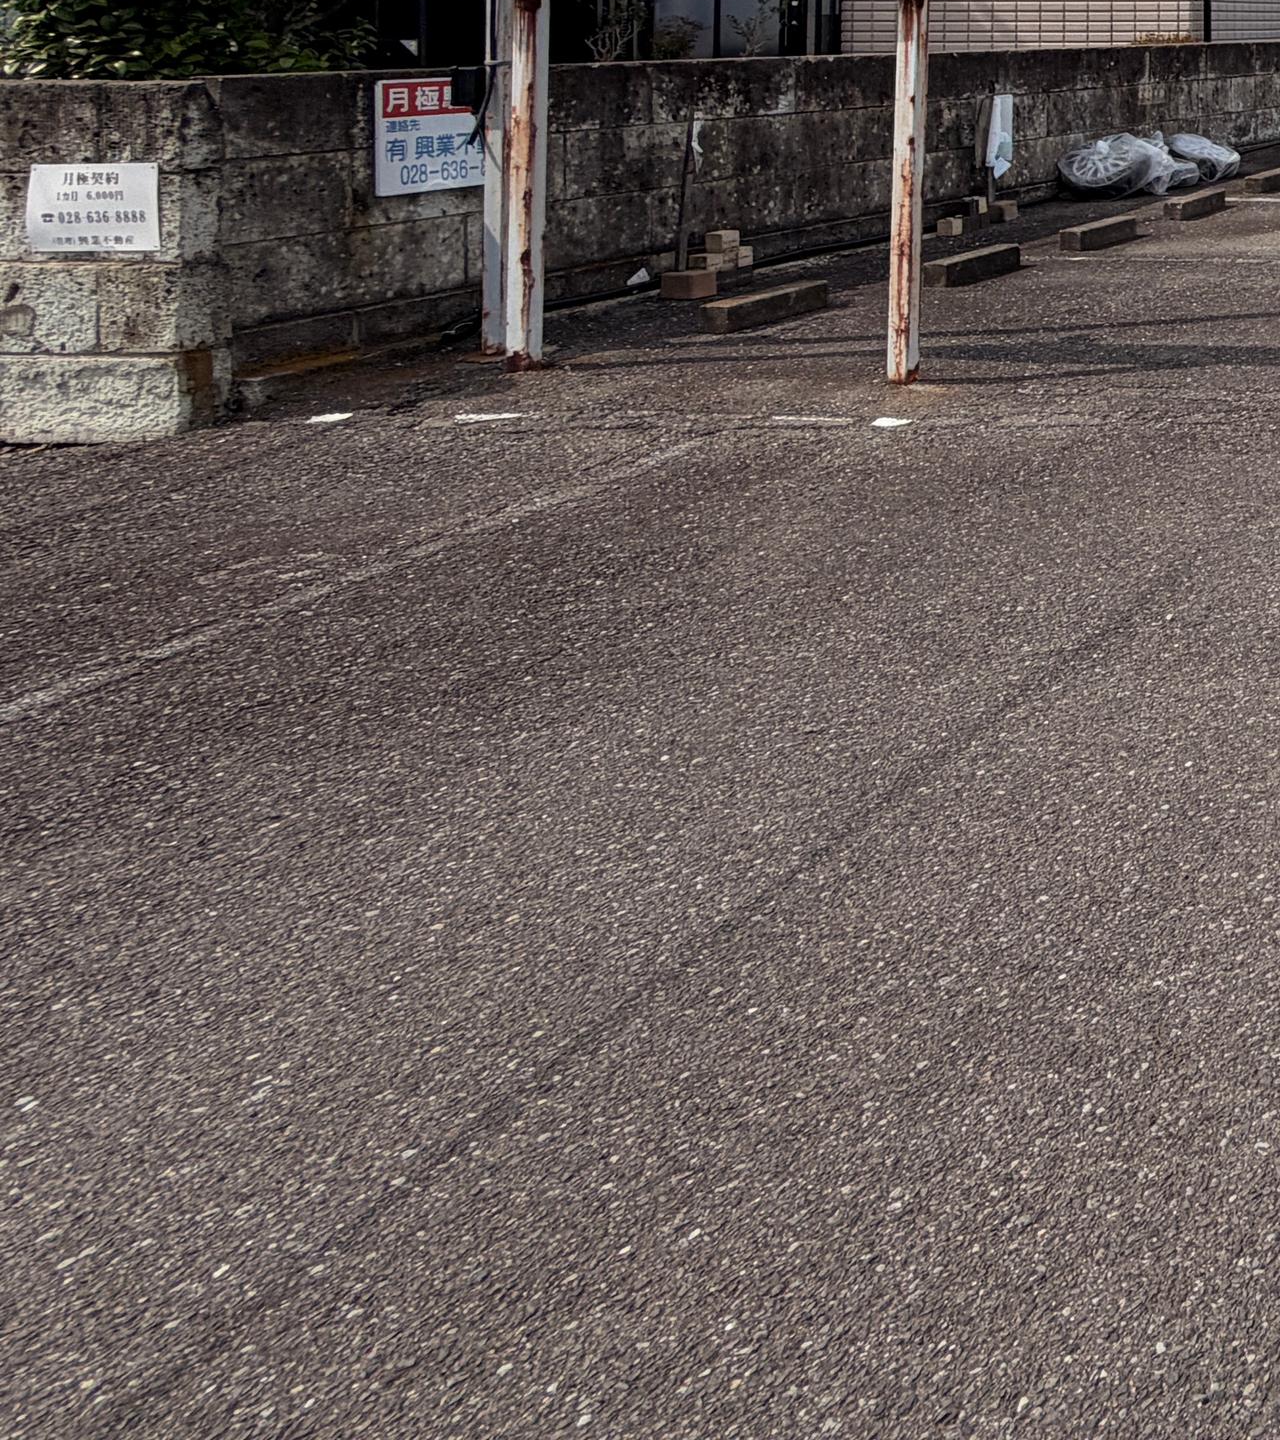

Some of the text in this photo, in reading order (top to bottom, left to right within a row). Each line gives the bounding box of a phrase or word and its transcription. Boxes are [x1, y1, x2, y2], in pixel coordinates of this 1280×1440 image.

[386, 119, 421, 133] 連絡先
[62, 171, 119, 186] 月極契約
